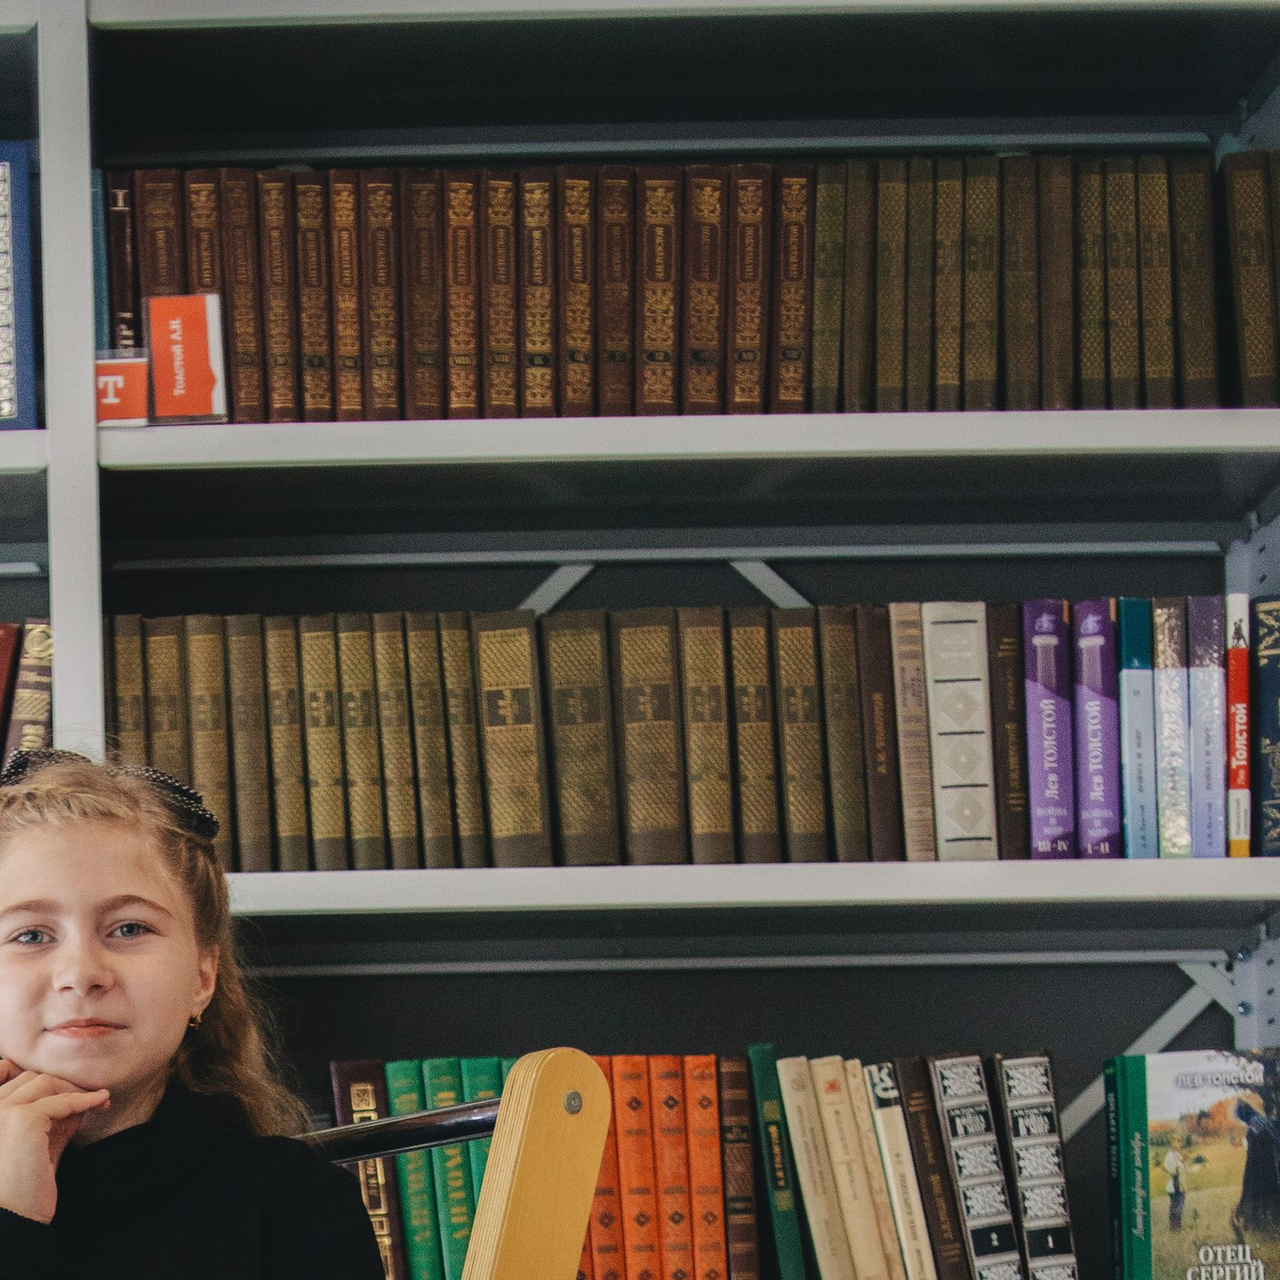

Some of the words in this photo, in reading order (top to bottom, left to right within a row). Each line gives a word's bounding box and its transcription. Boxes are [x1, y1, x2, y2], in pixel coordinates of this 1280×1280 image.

[99, 375, 125, 404] Т
[1039, 699, 1058, 770] ТОЛСТОЙ
[1085, 701, 1103, 773] ТОЛСТОЙ
[1045, 773, 1059, 799] Лев
[1089, 775, 1105, 802] Лев
[1176, 1076, 1202, 1088] ЛЕВ
[1207, 1069, 1264, 1087] ТОЛСТОЙ
[1199, 1245, 1253, 1263] ОТЕЦ
